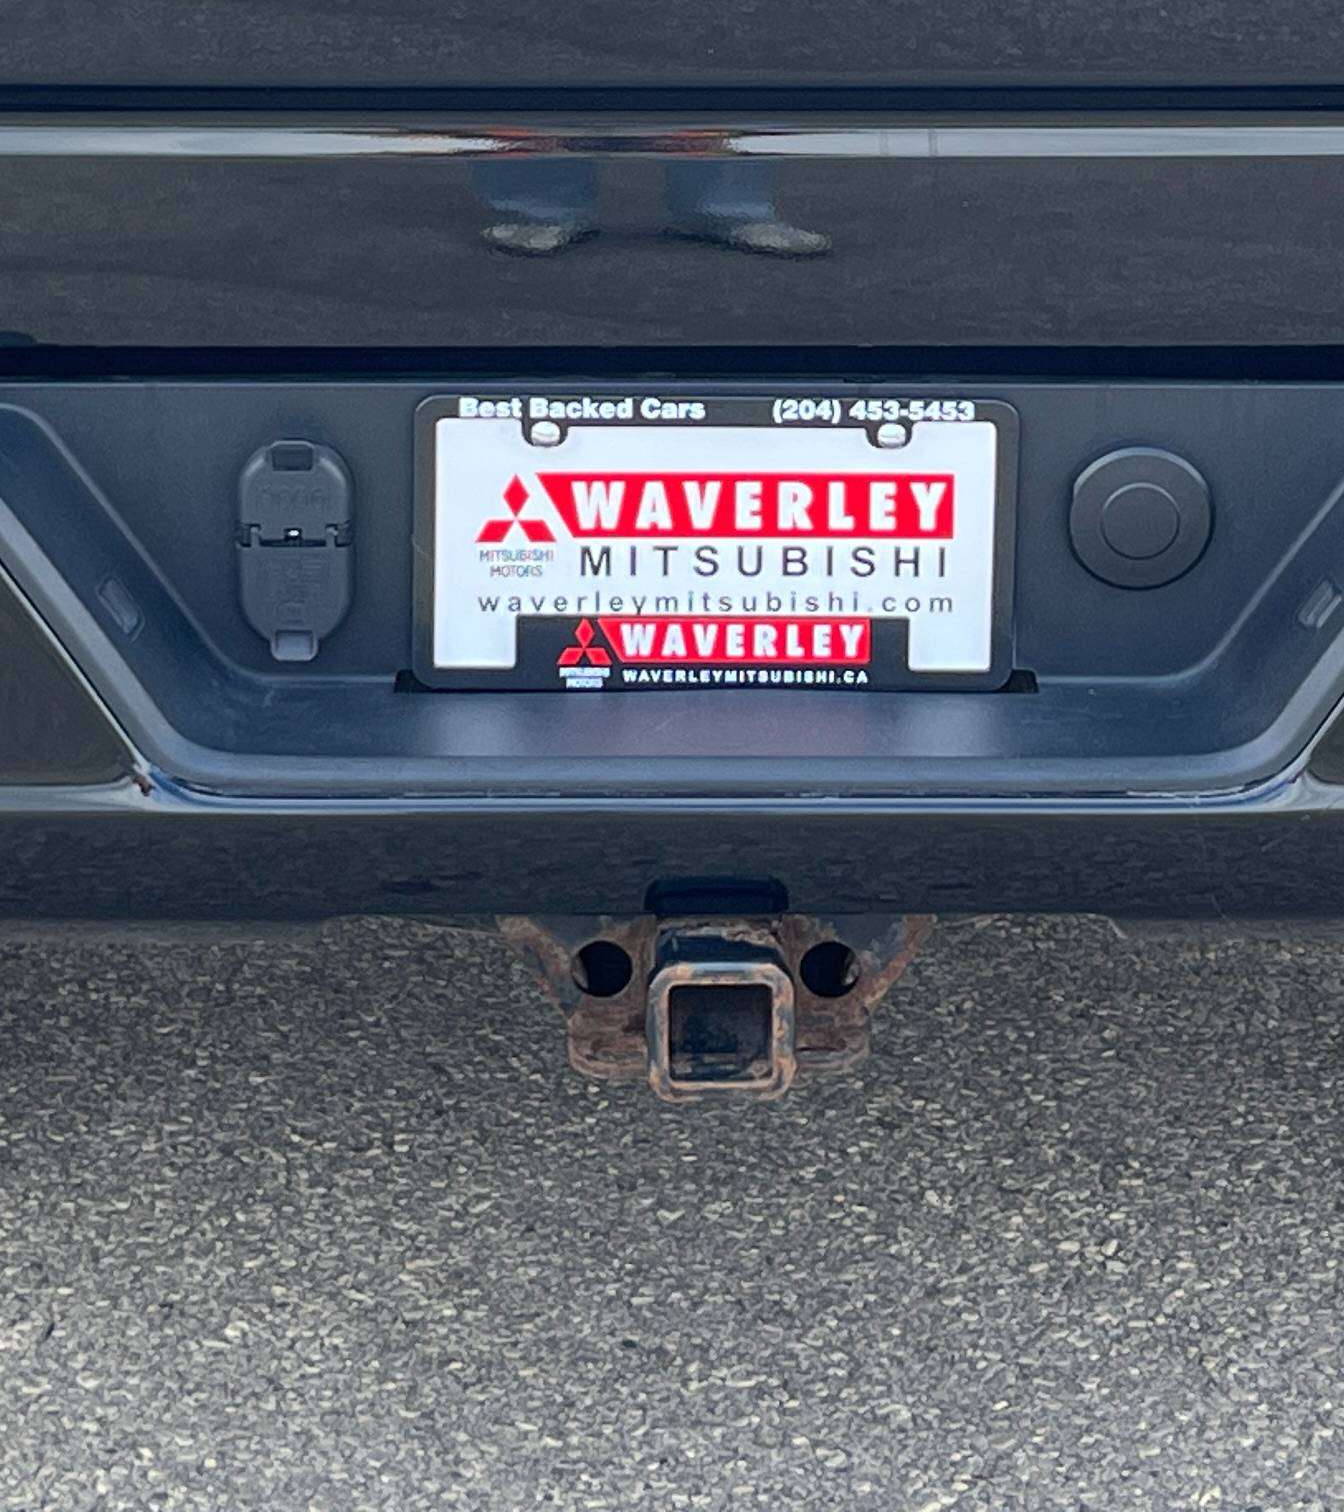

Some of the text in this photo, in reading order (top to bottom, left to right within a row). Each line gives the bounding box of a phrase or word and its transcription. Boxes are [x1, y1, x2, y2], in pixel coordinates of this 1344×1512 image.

[459, 396, 706, 419] Best Backed Cars
[772, 399, 976, 424] (204) 453-5453
[570, 480, 947, 531] WAVERLEY
[579, 545, 947, 577] MITSUBISHI
[477, 590, 954, 615] waverleymitsubishi.com
[619, 623, 865, 657] WAVERLEY
[622, 669, 869, 684] WAVERLEYMITSUBISHI.CA
